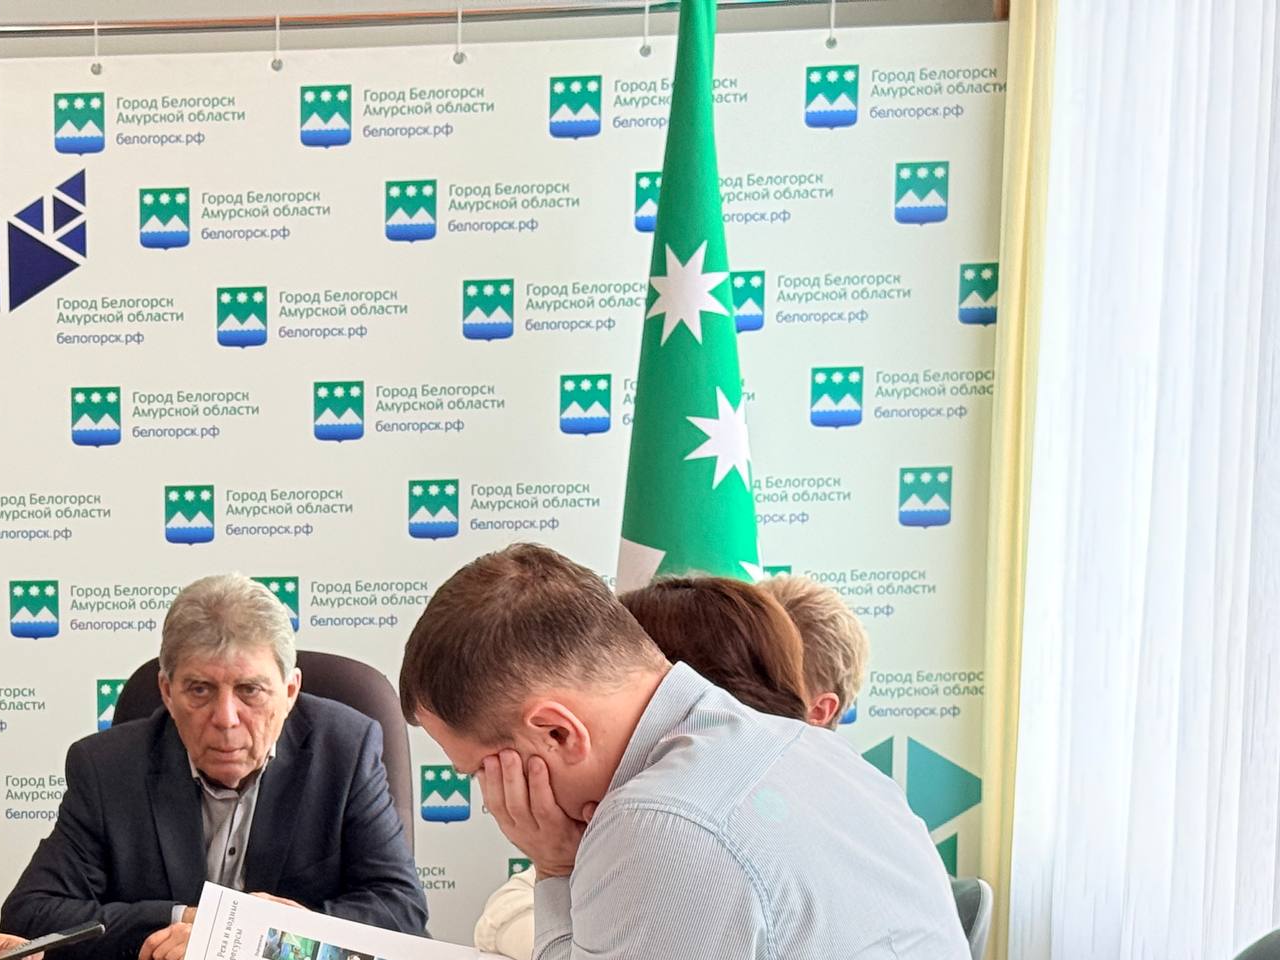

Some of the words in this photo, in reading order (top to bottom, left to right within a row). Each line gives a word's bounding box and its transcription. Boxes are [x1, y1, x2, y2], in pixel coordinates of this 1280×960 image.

[872, 69, 914, 85] Город
[919, 67, 998, 82] Белогорск
[615, 80, 657, 96] Город
[871, 82, 942, 99] Амурской
[117, 97, 158, 113] Город
[162, 97, 235, 111] Белогорск
[364, 90, 405, 106] Город
[410, 89, 484, 104] Белогорск
[712, 91, 747, 105] асти
[116, 110, 184, 125] Амурской
[188, 109, 245, 122] области
[363, 103, 432, 119] Амурской
[436, 102, 494, 115] области
[869, 103, 964, 120] белогорск.рф
[613, 115, 666, 129] белогор
[362, 122, 454, 139] белогорск.рф
[115, 131, 206, 147] белогорск.рф
[747, 174, 823, 189] Белогорск
[202, 192, 243, 208] Город
[247, 191, 320, 206] Белогорск
[449, 184, 491, 200] Город
[495, 183, 569, 197] Белогорск
[720, 189, 769, 205] урской
[773, 187, 833, 200] области
[201, 205, 269, 220] Амурской
[273, 204, 330, 217] области
[448, 197, 517, 213] Амурской
[521, 195, 579, 209] области
[723, 208, 791, 225] огорск.рф
[447, 217, 539, 233] белогорск.рф
[200, 225, 291, 242] белогорск.рф
[778, 274, 820, 290] Город
[824, 272, 900, 287] Белогорск
[280, 291, 321, 306] Город
[324, 290, 397, 304] Белогорск
[527, 283, 568, 299] Город
[777, 287, 847, 303] Амурской
[851, 285, 911, 299] области
[57, 298, 98, 313] Город
[101, 298, 173, 312] Белогорск
[279, 304, 346, 319] Амурской
[350, 303, 407, 316] области
[526, 296, 595, 312] Амурской
[600, 294, 644, 308] облас
[57, 311, 123, 326] Амурской
[127, 310, 184, 323] области
[775, 309, 869, 324] белогорск.рф
[278, 324, 368, 340] белогорск.рф
[524, 317, 617, 333] белогорск.рф
[56, 331, 145, 347] белогорск.рф
[876, 371, 919, 387] Город
[376, 387, 417, 402] Город
[421, 385, 494, 400] Белогорск
[875, 383, 946, 400] Амурской
[950, 381, 993, 395] облас
[133, 392, 173, 407] Город
[177, 391, 249, 405] Белогорск
[376, 399, 443, 415] Амурской
[447, 398, 504, 411] области
[132, 404, 199, 420] Амурской
[203, 403, 259, 416] области
[873, 405, 968, 420] белогорск.рф
[131, 424, 221, 440] белогорск.рф
[374, 418, 465, 434] белогорск.рф
[766, 474, 840, 489] Белогорск
[226, 490, 267, 505] Город
[271, 489, 342, 503] Белогорск
[471, 484, 512, 499] Город
[516, 483, 589, 497] Белогорск
[754, 488, 788, 504] ской
[792, 487, 851, 500] области
[30, 494, 101, 508] Белогорск
[471, 497, 538, 512] Амурской
[543, 495, 600, 508] области
[55, 506, 110, 519] области
[226, 503, 292, 518] Амурской
[296, 502, 353, 515] области
[469, 516, 560, 532] белогорск.рф
[756, 511, 810, 526] орск.рф
[225, 522, 314, 538] белогорск.рф
[851, 569, 925, 583] Белогорск
[70, 586, 111, 601] Город
[311, 582, 351, 597] Город
[355, 581, 427, 595] Белогорск
[877, 581, 935, 595] области
[70, 599, 136, 614] Амурской
[141, 598, 172, 611] обла
[310, 594, 377, 610] Амурской
[382, 594, 429, 606] област
[69, 617, 157, 633] белогорск.рф
[309, 614, 399, 629] белогорск.рф
[870, 672, 912, 688] Город
[916, 670, 984, 684] Белогорс
[869, 684, 938, 701] Амурской
[942, 682, 984, 696] облас
[868, 705, 961, 719] белогорск.рф
[6, 776, 45, 791] Город
[6, 789, 62, 804] Амурско
